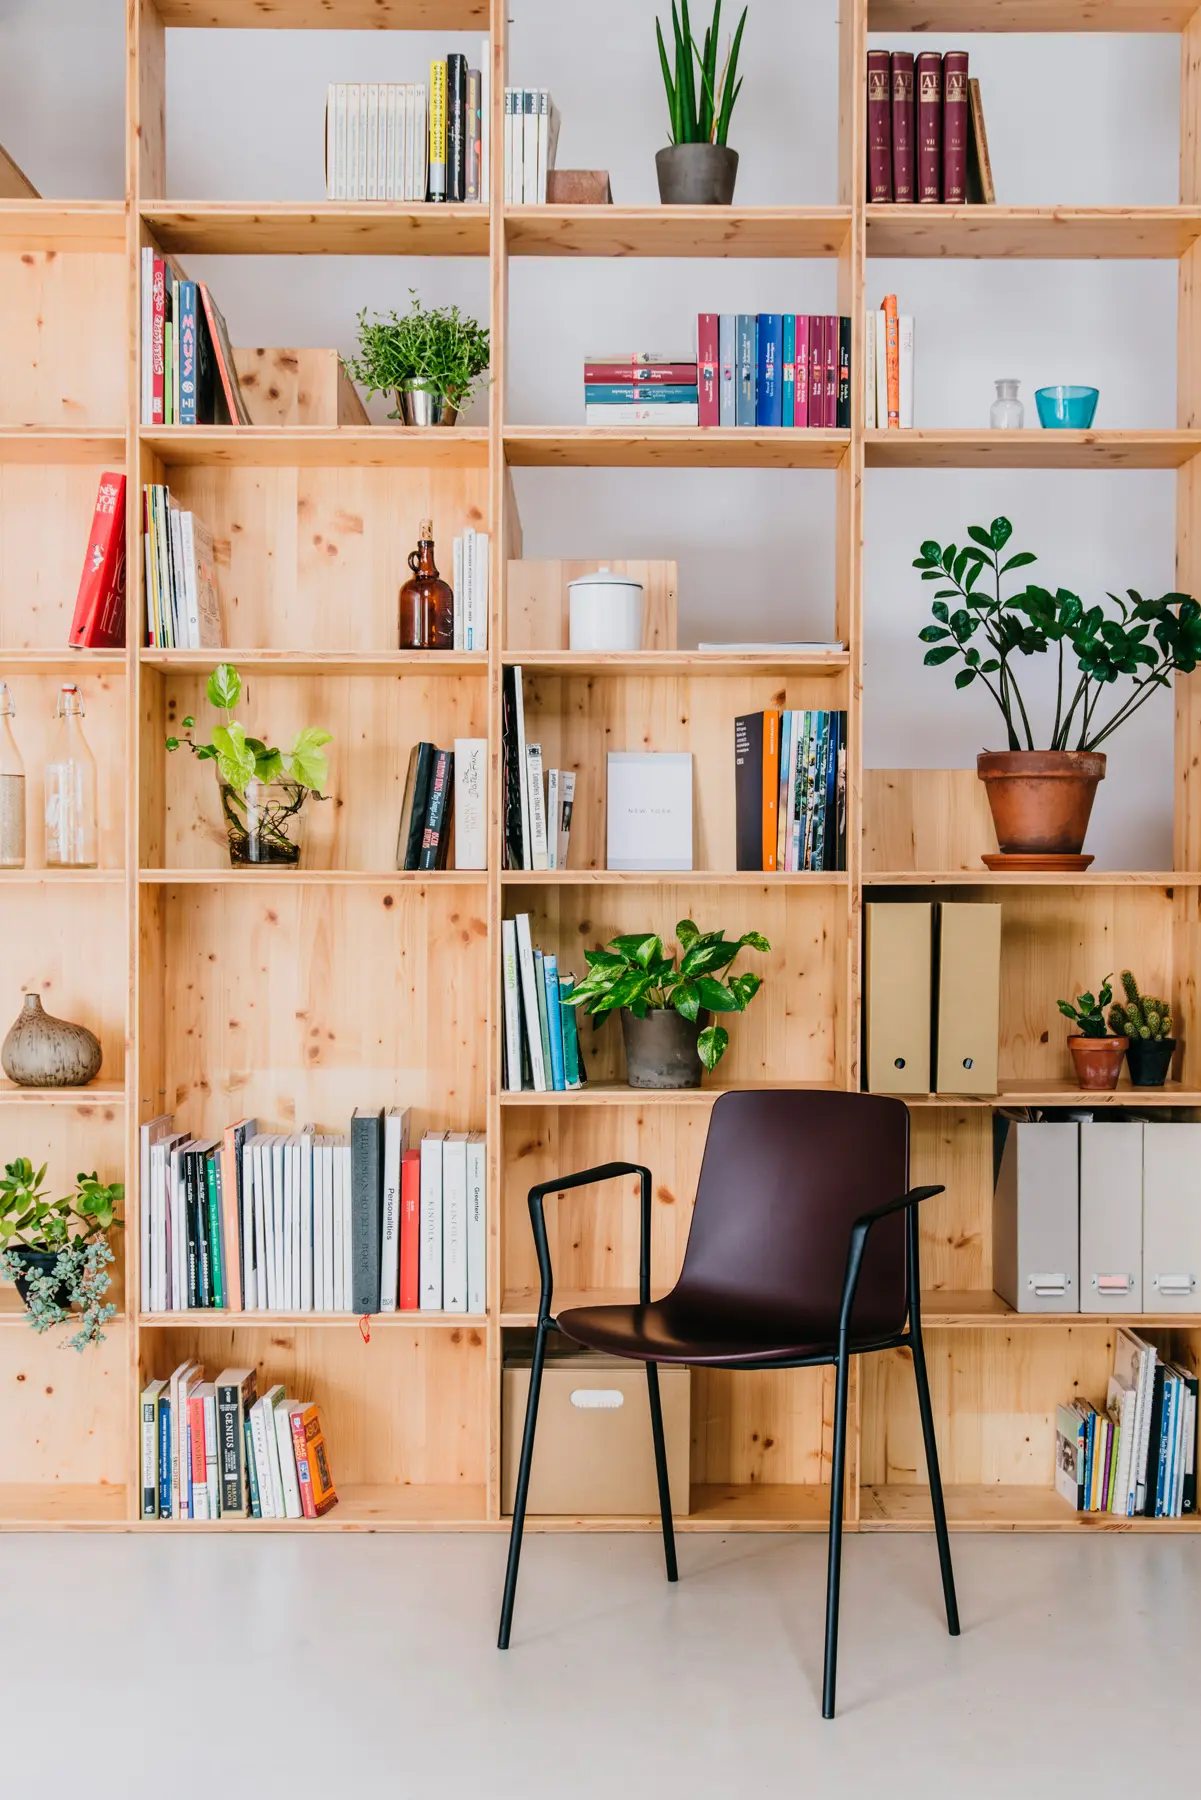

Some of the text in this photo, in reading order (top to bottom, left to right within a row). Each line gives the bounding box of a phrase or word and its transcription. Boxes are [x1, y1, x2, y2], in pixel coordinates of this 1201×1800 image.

[433, 65, 443, 158] CRAZY FOR THE STORM
[183, 314, 195, 377] MAUS
[97, 495, 116, 505] YOR
[99, 485, 118, 496] NEW
[95, 503, 115, 514] KER
[429, 801, 441, 813] Songs
[431, 791, 442, 801] Play
[428, 816, 438, 827] Love
[360, 1124, 369, 1273] THE DESIGN HOTELS BOOK
[473, 1186, 481, 1222] Greenterior
[386, 1187, 395, 1240] Personalities
[225, 1412, 234, 1449] GENIUS
[294, 1434, 303, 1460] ASIMOV
[299, 1436, 307, 1457] ISAAC
